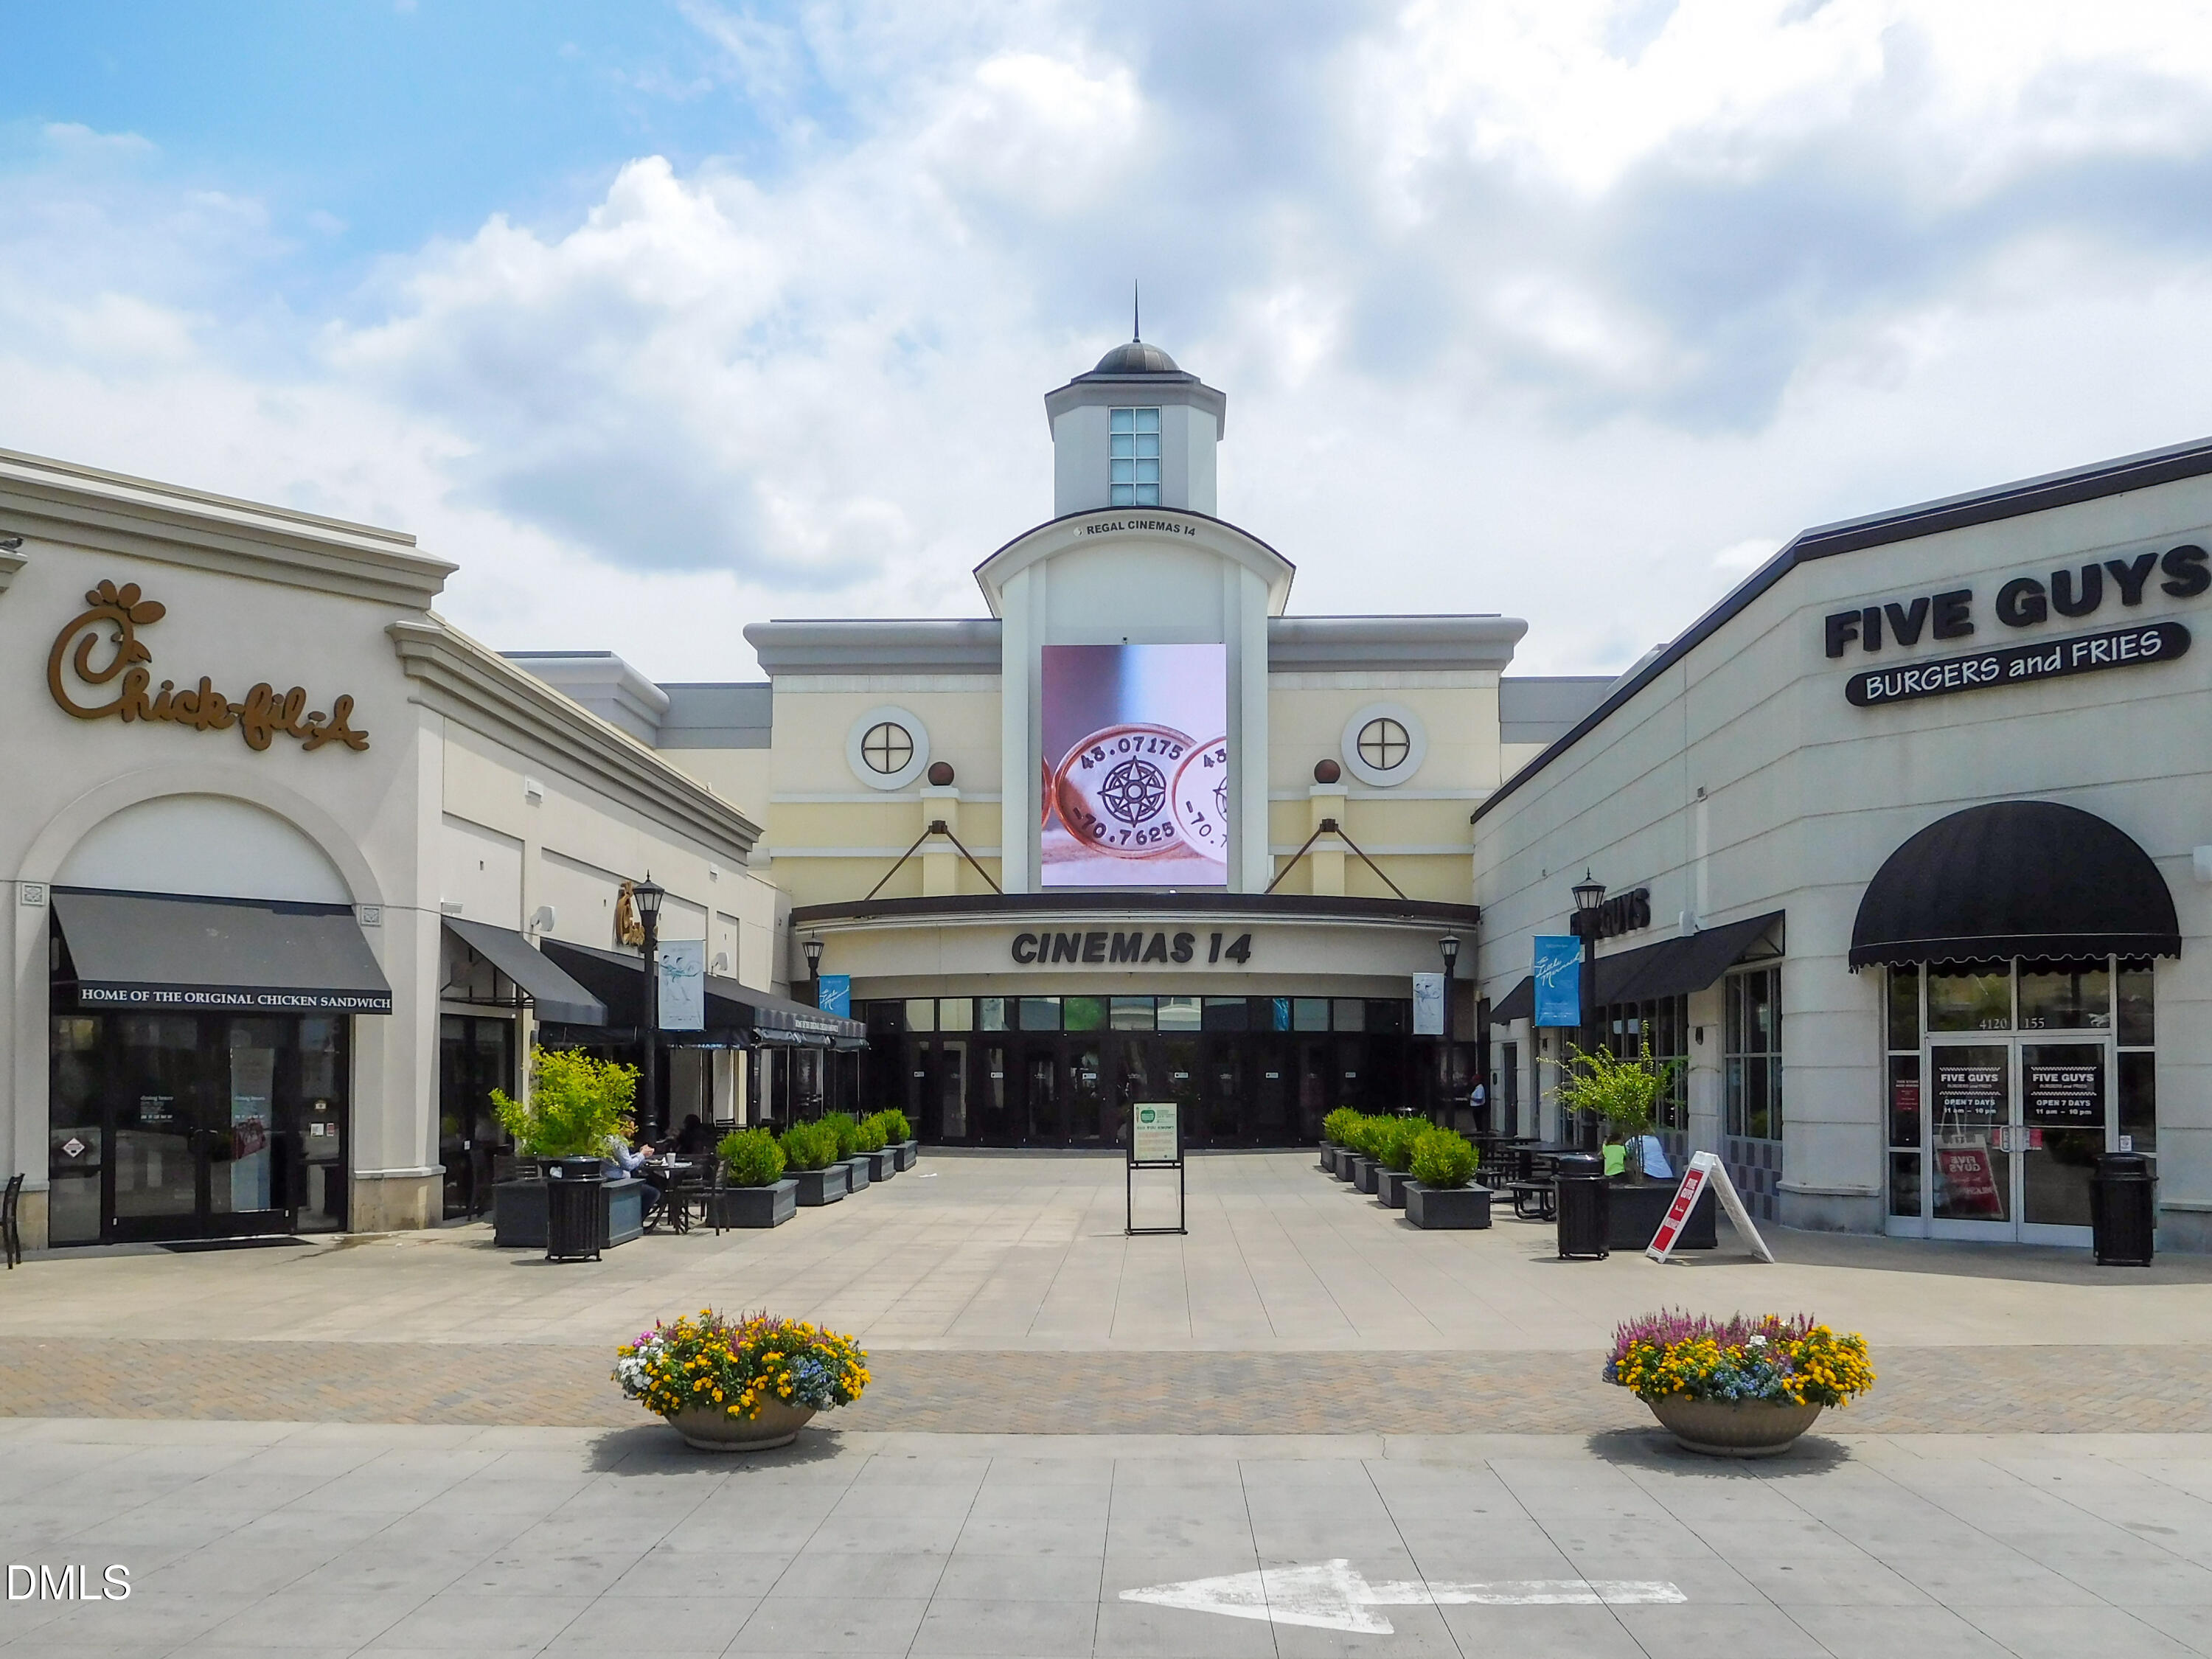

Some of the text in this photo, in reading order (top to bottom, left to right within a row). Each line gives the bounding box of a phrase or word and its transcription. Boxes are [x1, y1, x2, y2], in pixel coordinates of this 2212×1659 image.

[1087, 520, 1196, 537] REGAL CINEMAS 14
[1825, 544, 2212, 658] FIVE GUYS
[47, 580, 370, 751] Chick-fil-A
[1865, 630, 2163, 700] BURGERS and FRIES
[1011, 932, 1252, 964] CINEMAS 14
[82, 989, 391, 1009] HOME OF THE ORIGINAL CHICKEN SANDWICH
[1979, 1018, 2045, 1029] 4120 155
[2033, 1074, 2094, 1082] FIVE GUYS
